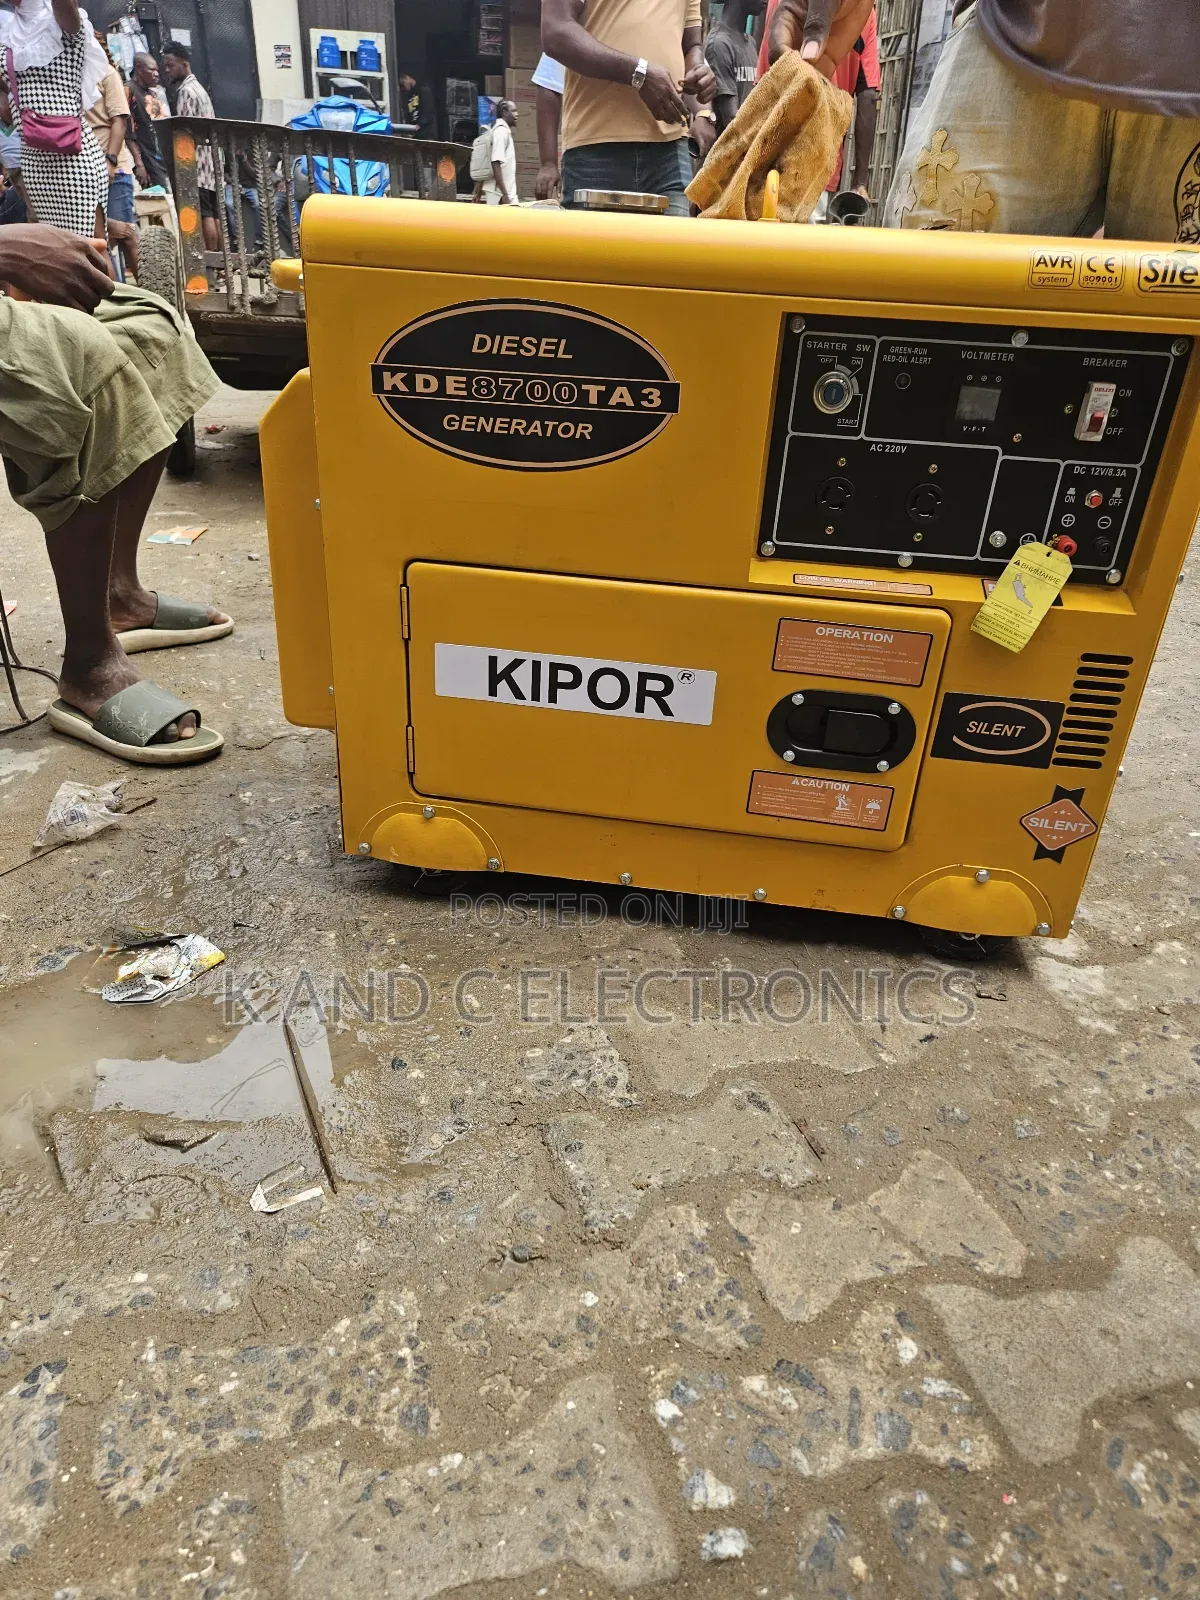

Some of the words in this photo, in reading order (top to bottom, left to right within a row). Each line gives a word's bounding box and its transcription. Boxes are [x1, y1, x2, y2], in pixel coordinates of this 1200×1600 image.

[1035, 254, 1073, 269] AVR
[1086, 256, 1116, 274] CE
[1037, 275, 1068, 285] system
[472, 333, 573, 359] DIESEL
[806, 340, 848, 351] STARTER
[855, 344, 872, 353] SW.
[889, 345, 928, 356] GREEN-RUN
[882, 354, 908, 364] RED-OIL
[910, 356, 932, 365] ALERT
[960, 350, 1015, 362] VOLTMETER
[1082, 357, 1128, 368] BREAKER
[382, 371, 663, 408] KDE8700TA3
[1118, 388, 1133, 398] ON
[442, 414, 594, 440] GENERATOR
[1106, 426, 1124, 436] OFF
[869, 443, 883, 452] AC
[884, 443, 908, 454] 220V
[1073, 466, 1087, 475] DC
[1090, 467, 1127, 478] 12V/8.3A
[1064, 494, 1076, 504] ON
[1108, 498, 1124, 507] OFF
[1020, 562, 1062, 585] ВНИМАНИЕ
[799, 574, 819, 582] LOW
[834, 577, 877, 587] WARNING!
[815, 626, 894, 644] OPERATION
[966, 720, 1026, 738] SILENT
[800, 778, 850, 792] CAUTION
[1028, 816, 1090, 833] SILENT
